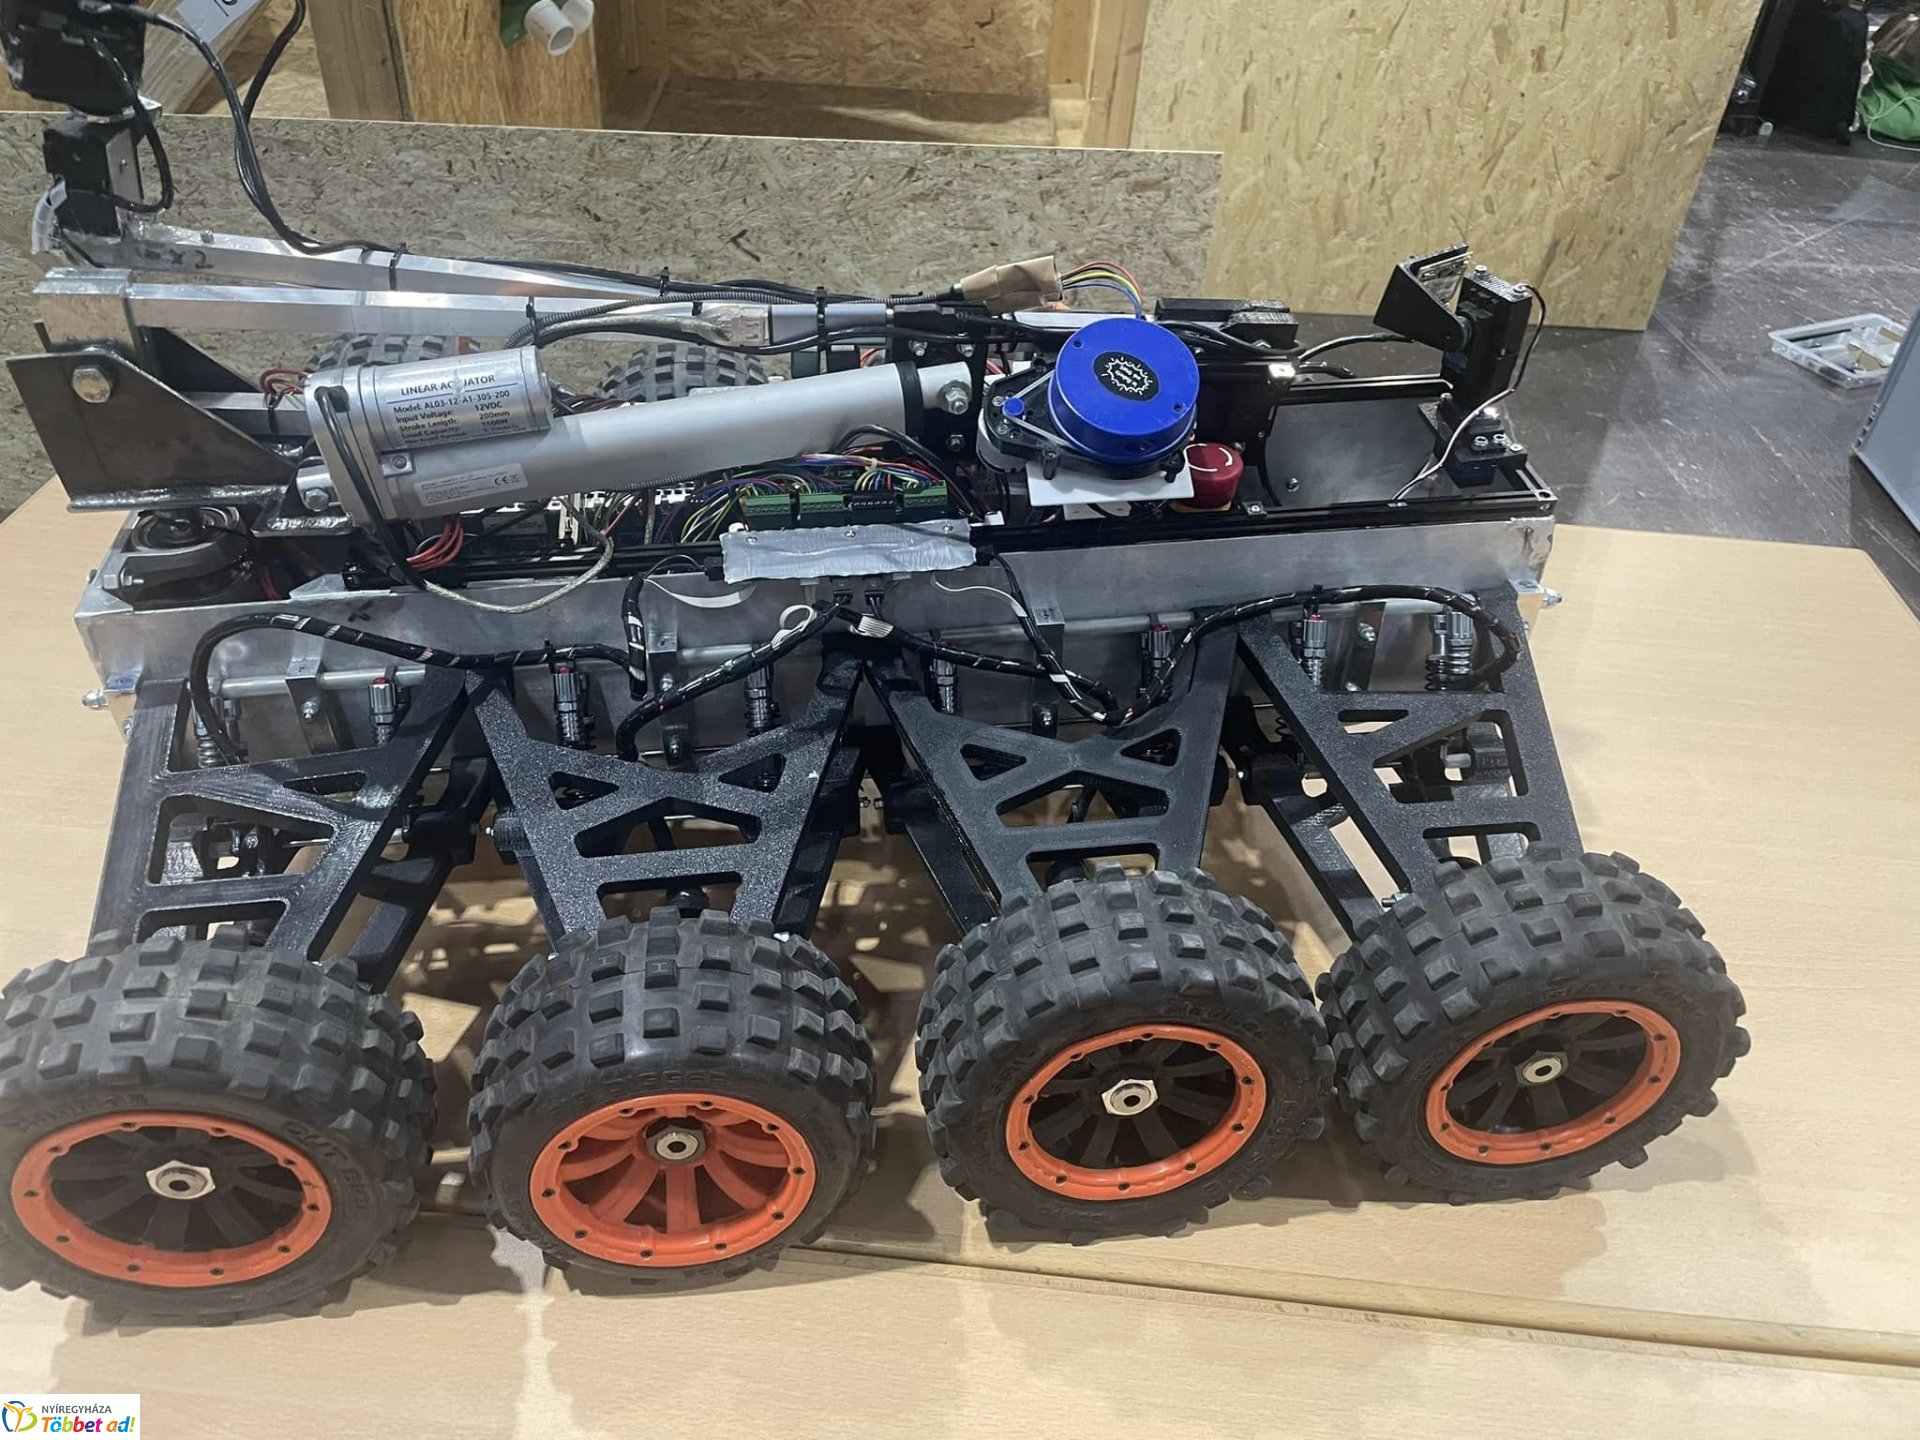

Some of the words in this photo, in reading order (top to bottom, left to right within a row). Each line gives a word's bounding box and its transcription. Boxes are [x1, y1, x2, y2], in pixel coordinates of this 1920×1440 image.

[401, 382, 438, 396] LINEAR
[440, 374, 496, 390] ACUATOR
[396, 414, 419, 424] Input
[474, 400, 503, 412] 12VDC
[399, 422, 426, 432] Stroke
[479, 410, 511, 420] 200mm
